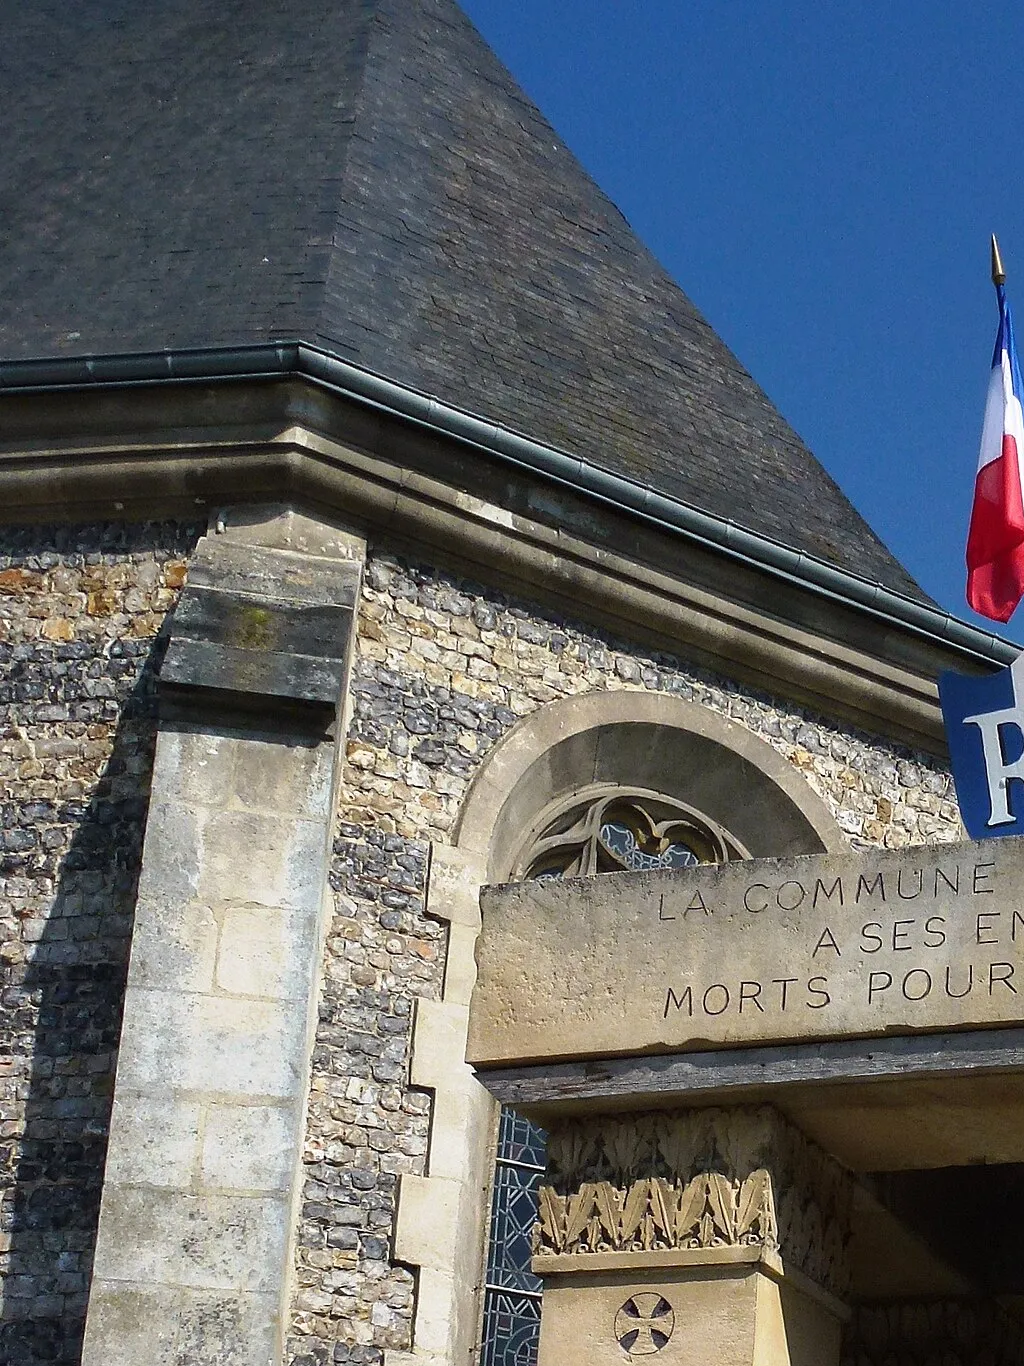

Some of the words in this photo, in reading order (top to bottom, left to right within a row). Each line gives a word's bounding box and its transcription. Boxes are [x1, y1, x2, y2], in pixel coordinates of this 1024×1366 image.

[659, 889, 710, 921] LA
[744, 862, 995, 914] COMMUNE
[812, 927, 841, 958] A
[860, 916, 947, 953] SES
[664, 976, 831, 1019] MORTS
[868, 962, 1018, 1004] POUR
